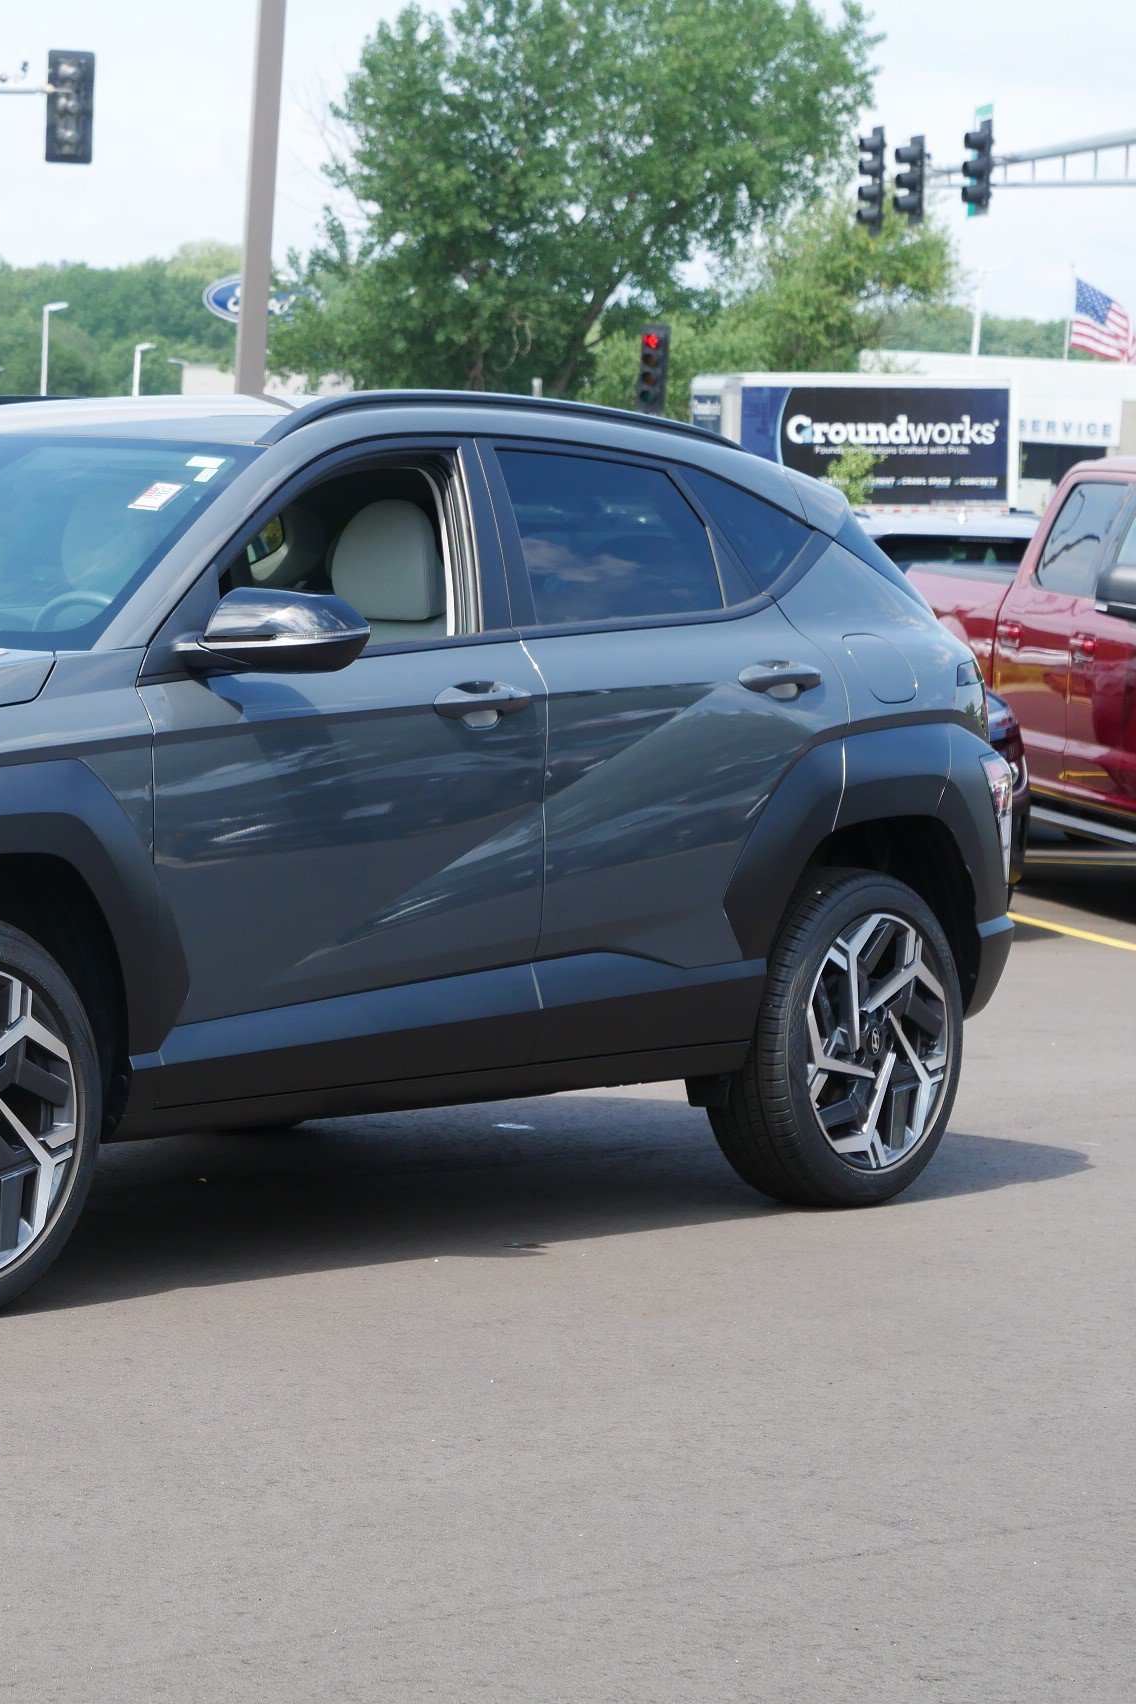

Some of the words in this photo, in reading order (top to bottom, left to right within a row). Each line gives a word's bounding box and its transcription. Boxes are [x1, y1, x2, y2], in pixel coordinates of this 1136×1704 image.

[786, 414, 996, 444] Groundworks
[1018, 419, 1112, 436] SERVICE
[898, 445, 928, 455] Crafted
[929, 446, 947, 455] with
[948, 446, 970, 455] Pride.
[960, 477, 998, 486] CONCRETE
